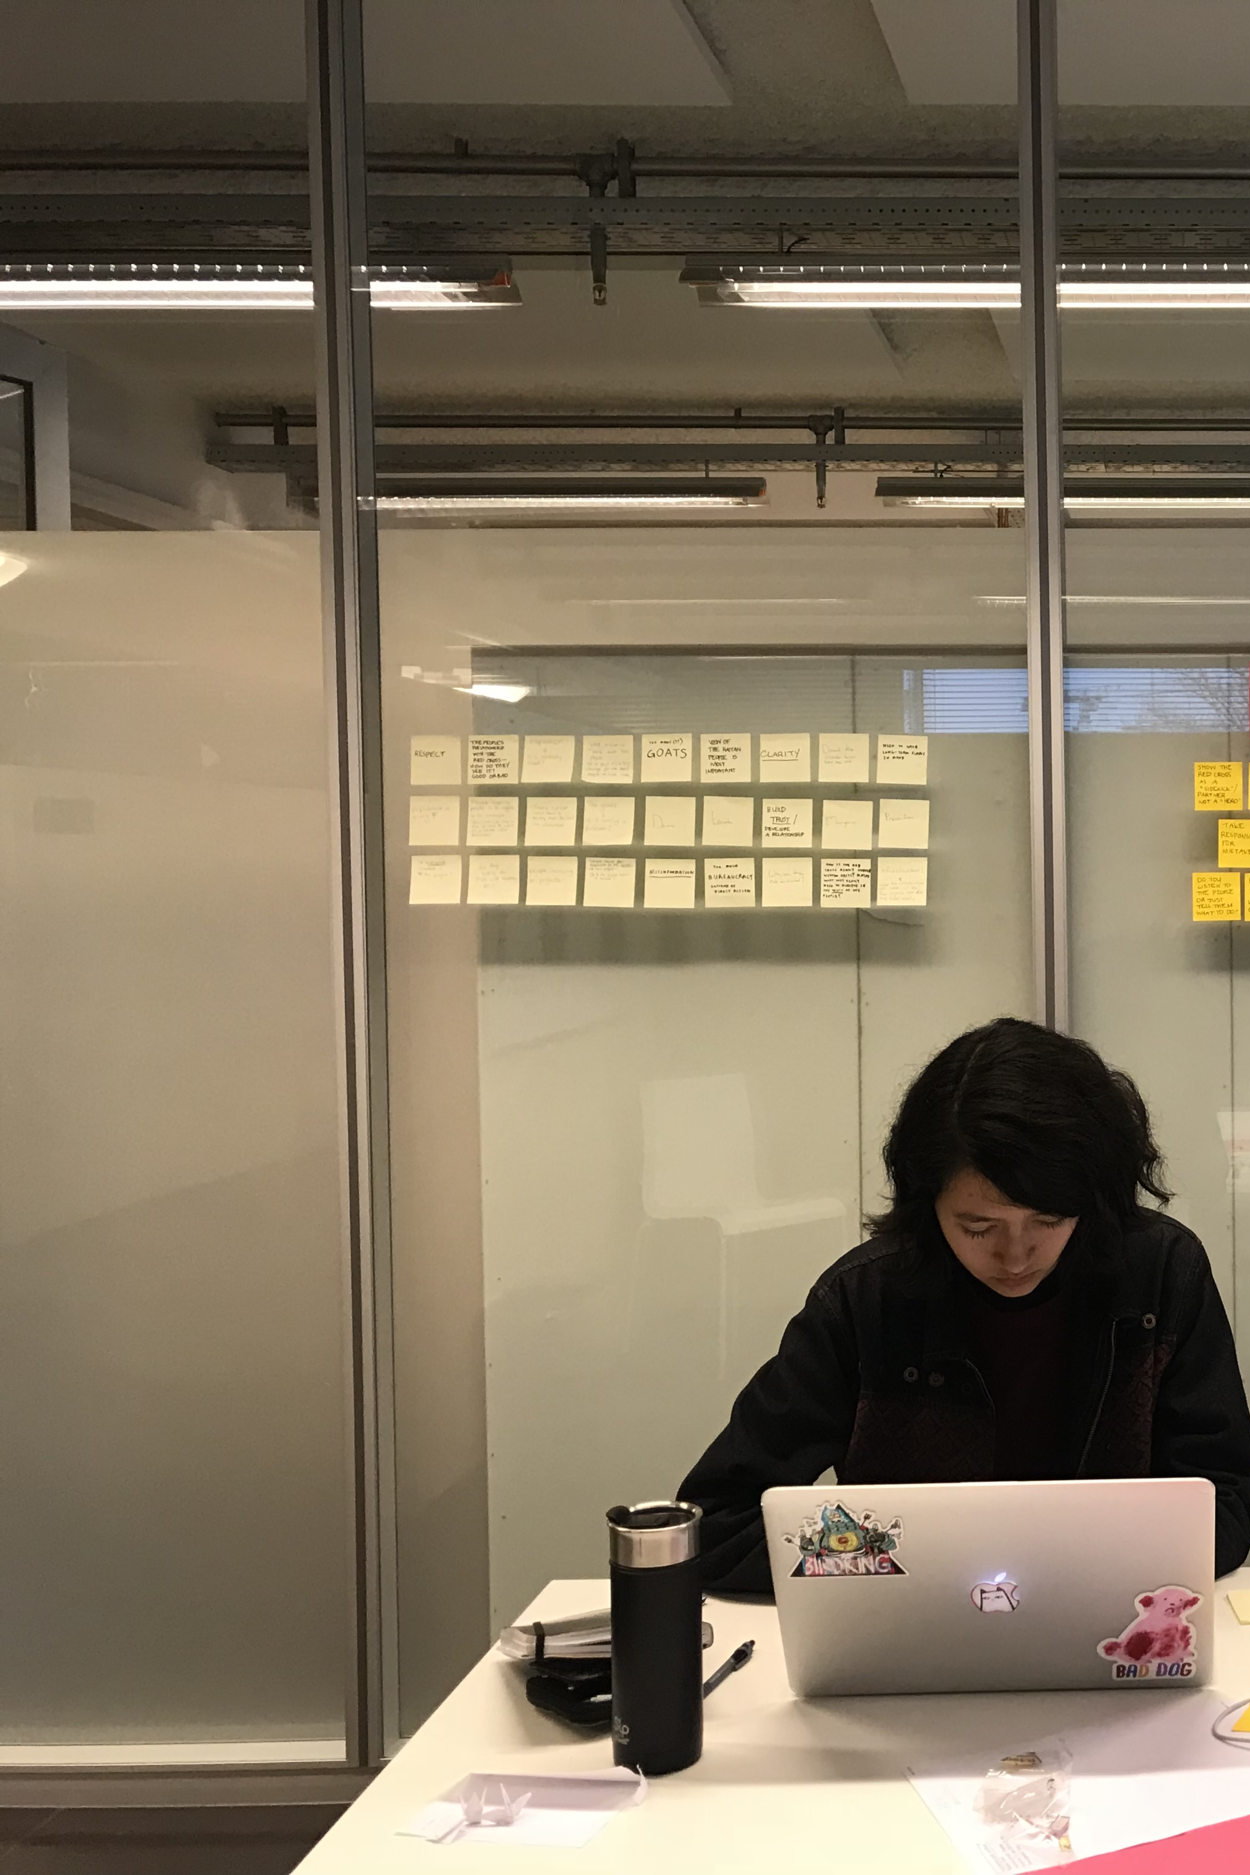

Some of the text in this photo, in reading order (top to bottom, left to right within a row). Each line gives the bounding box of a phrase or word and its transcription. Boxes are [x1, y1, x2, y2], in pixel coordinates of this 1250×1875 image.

[414, 750, 446, 758] RESPECT
[647, 748, 688, 759] GOATS
[760, 749, 800, 758] CLARITY
[1116, 1662, 1193, 1678] BAD DOG
